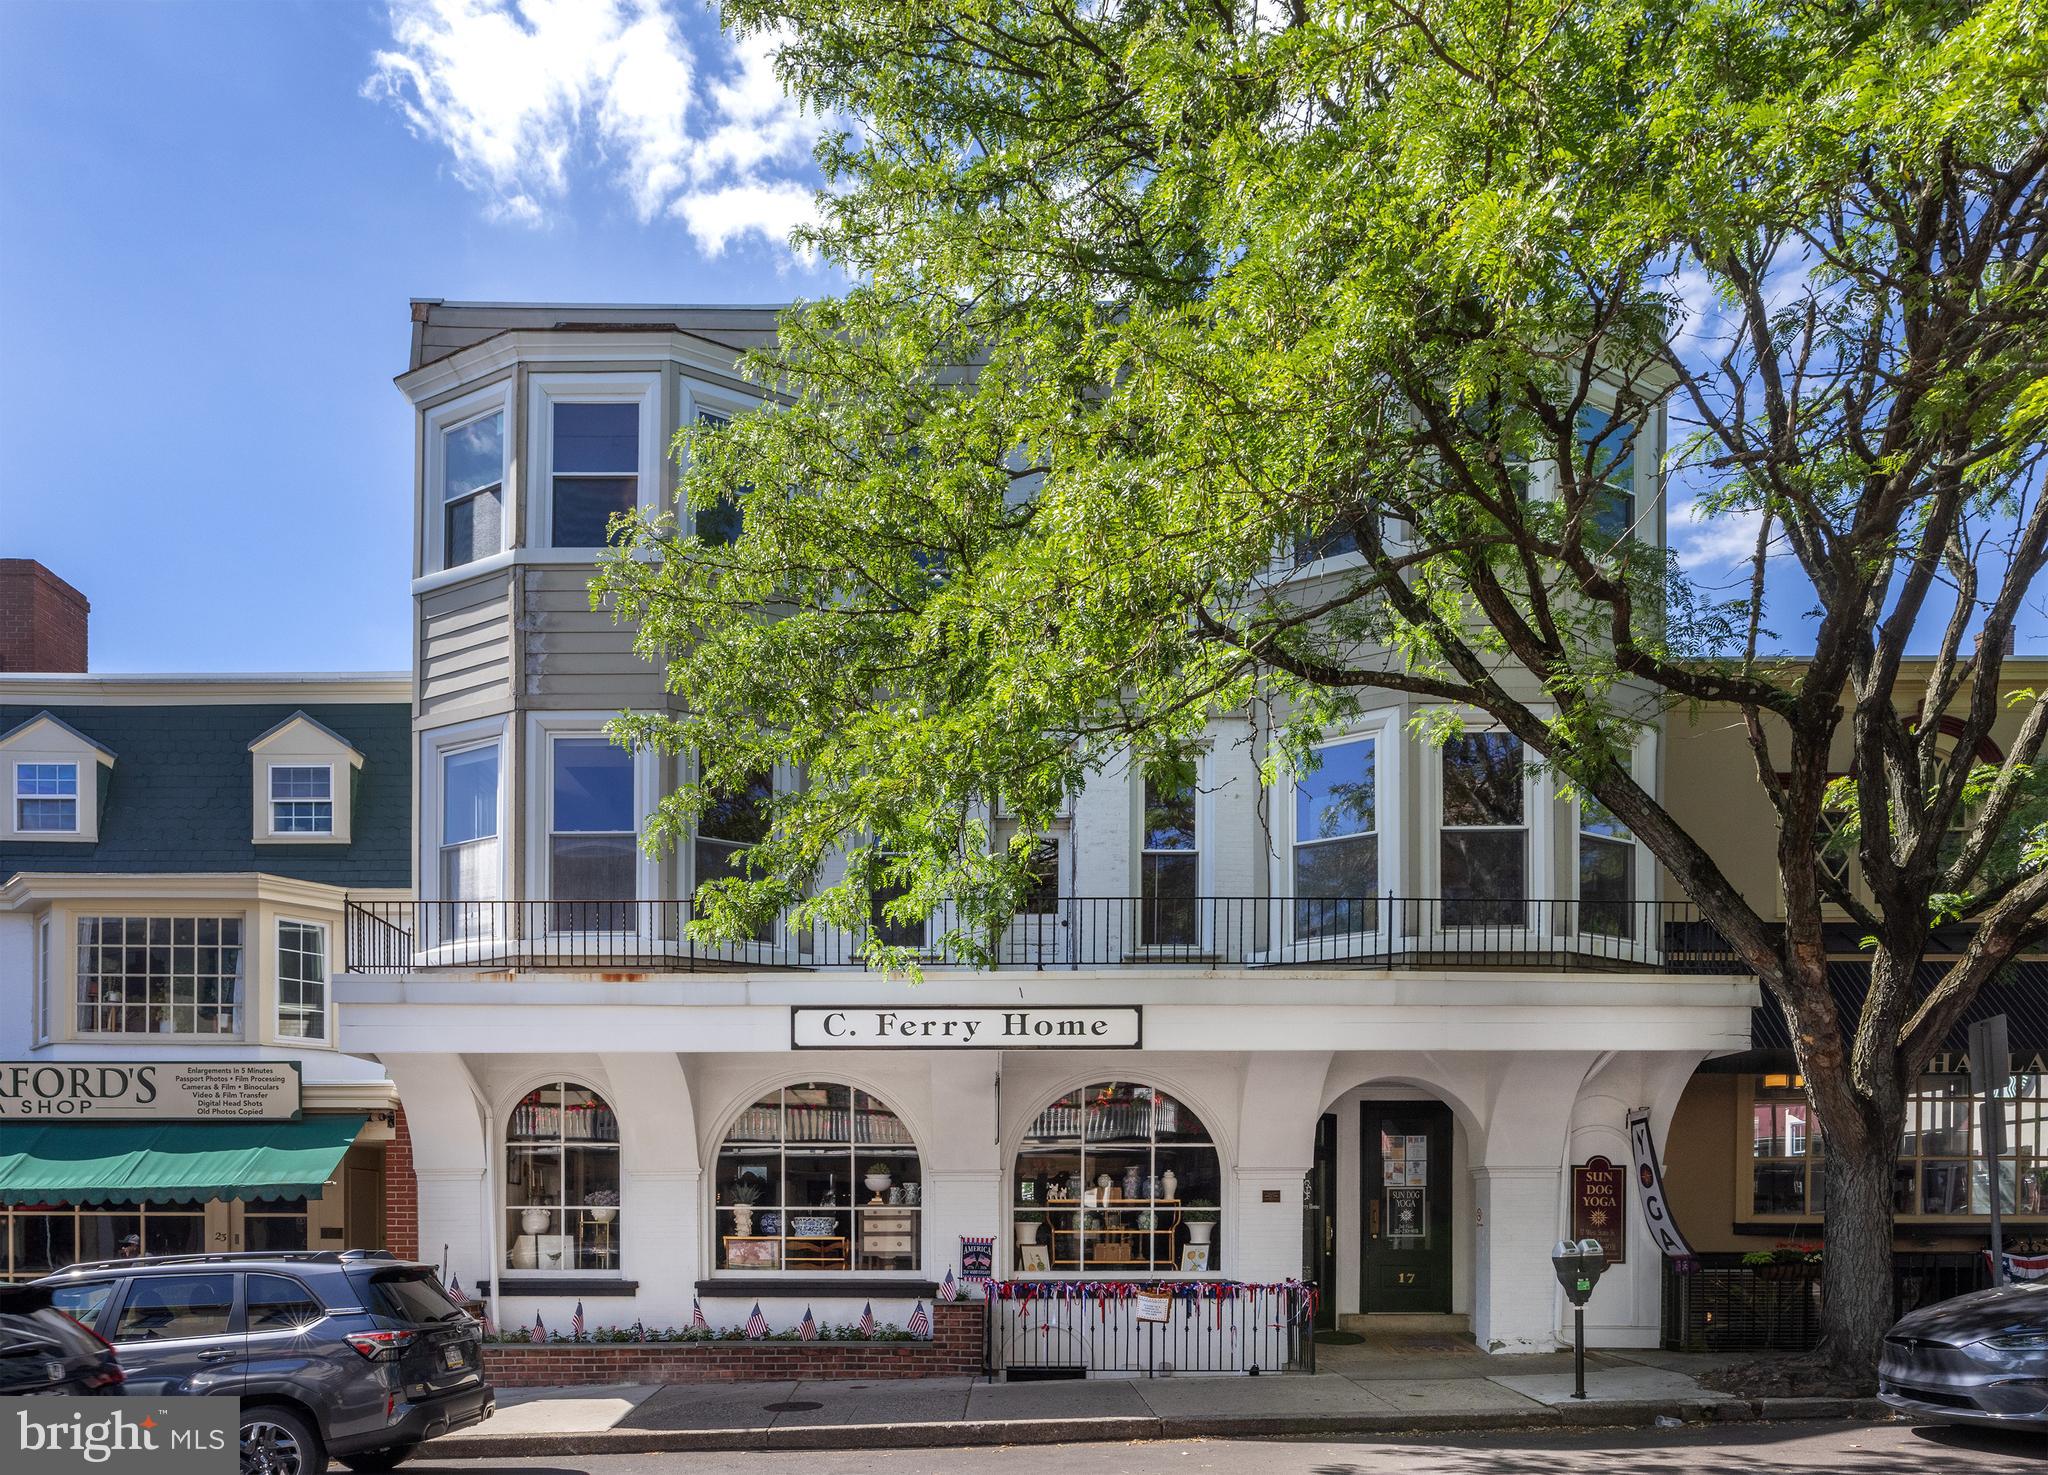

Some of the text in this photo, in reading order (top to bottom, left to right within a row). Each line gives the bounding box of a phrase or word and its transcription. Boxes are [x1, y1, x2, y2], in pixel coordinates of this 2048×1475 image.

[823, 1013, 1109, 1043] C. Ferry Home
[187, 1067, 232, 1075] Enlargements
[175, 1075, 204, 1083] Passport
[250, 1075, 286, 1083] Processing
[21, 1100, 92, 1114] SHOP
[198, 1100, 220, 1108] Digital
[238, 1108, 264, 1116] Copied
[1586, 1172, 1613, 1182] SUN
[1586, 1184, 1613, 1195] DOG
[1393, 1191, 1420, 1199] SUN DOG
[1583, 1197, 1617, 1207] YOGA
[964, 1246, 992, 1255] AMERICA
[1398, 1273, 1415, 1284] 17
